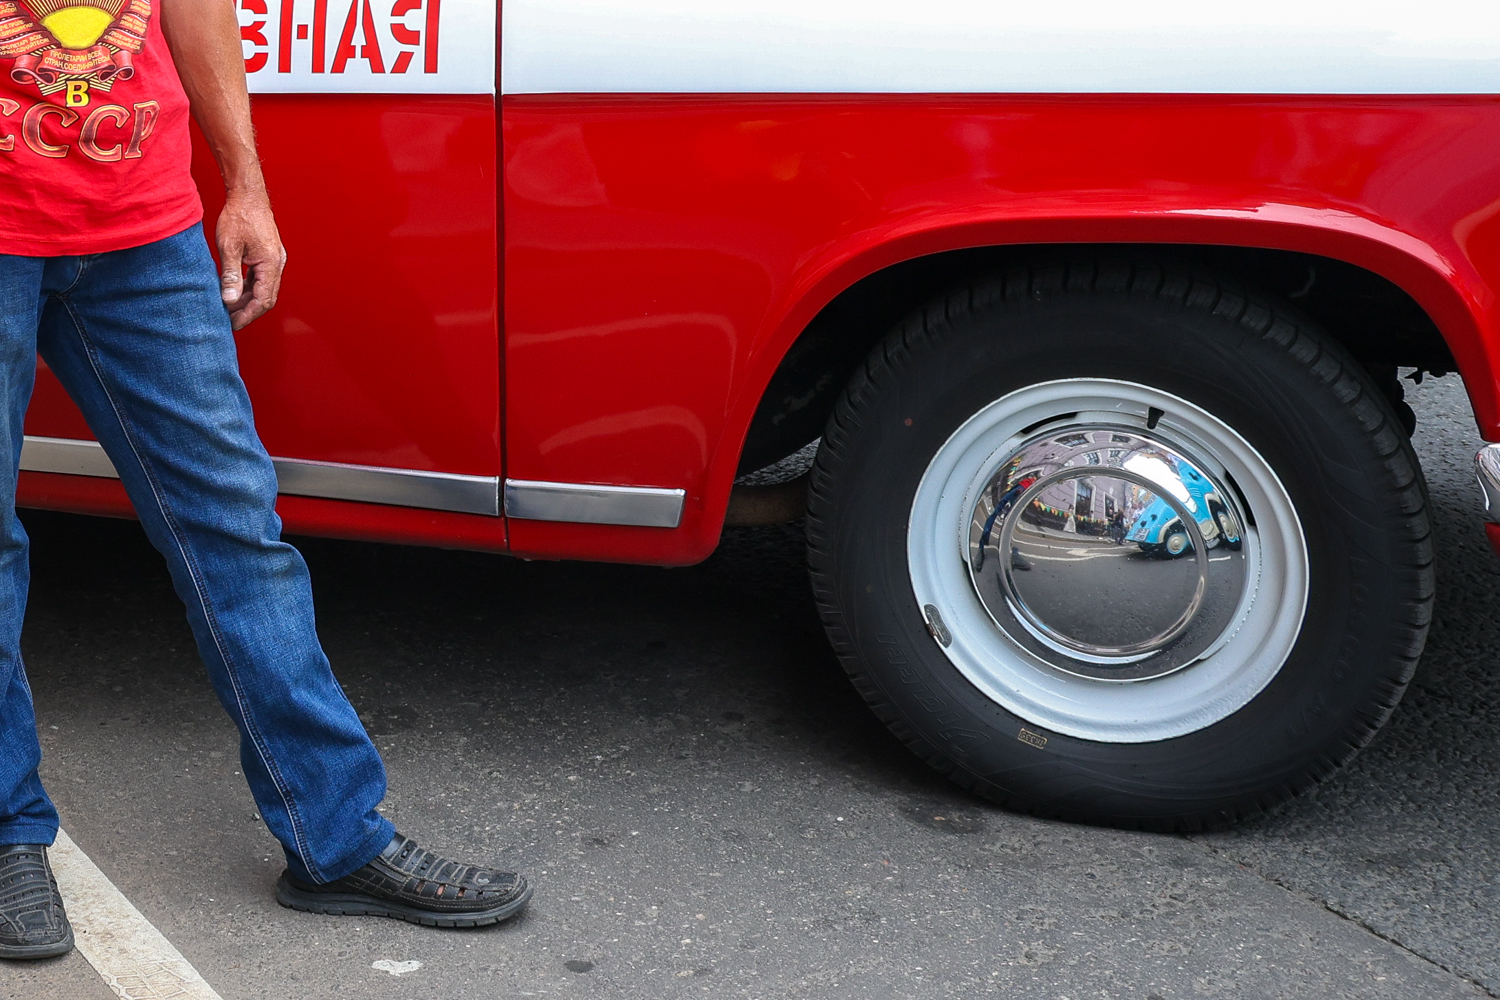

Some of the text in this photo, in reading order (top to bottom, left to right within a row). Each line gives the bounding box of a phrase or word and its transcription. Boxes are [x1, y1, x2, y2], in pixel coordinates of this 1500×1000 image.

[50, 49, 102, 62] ПРОЛЕТАРИИ ВСЕХ
[66, 81, 89, 107] В
